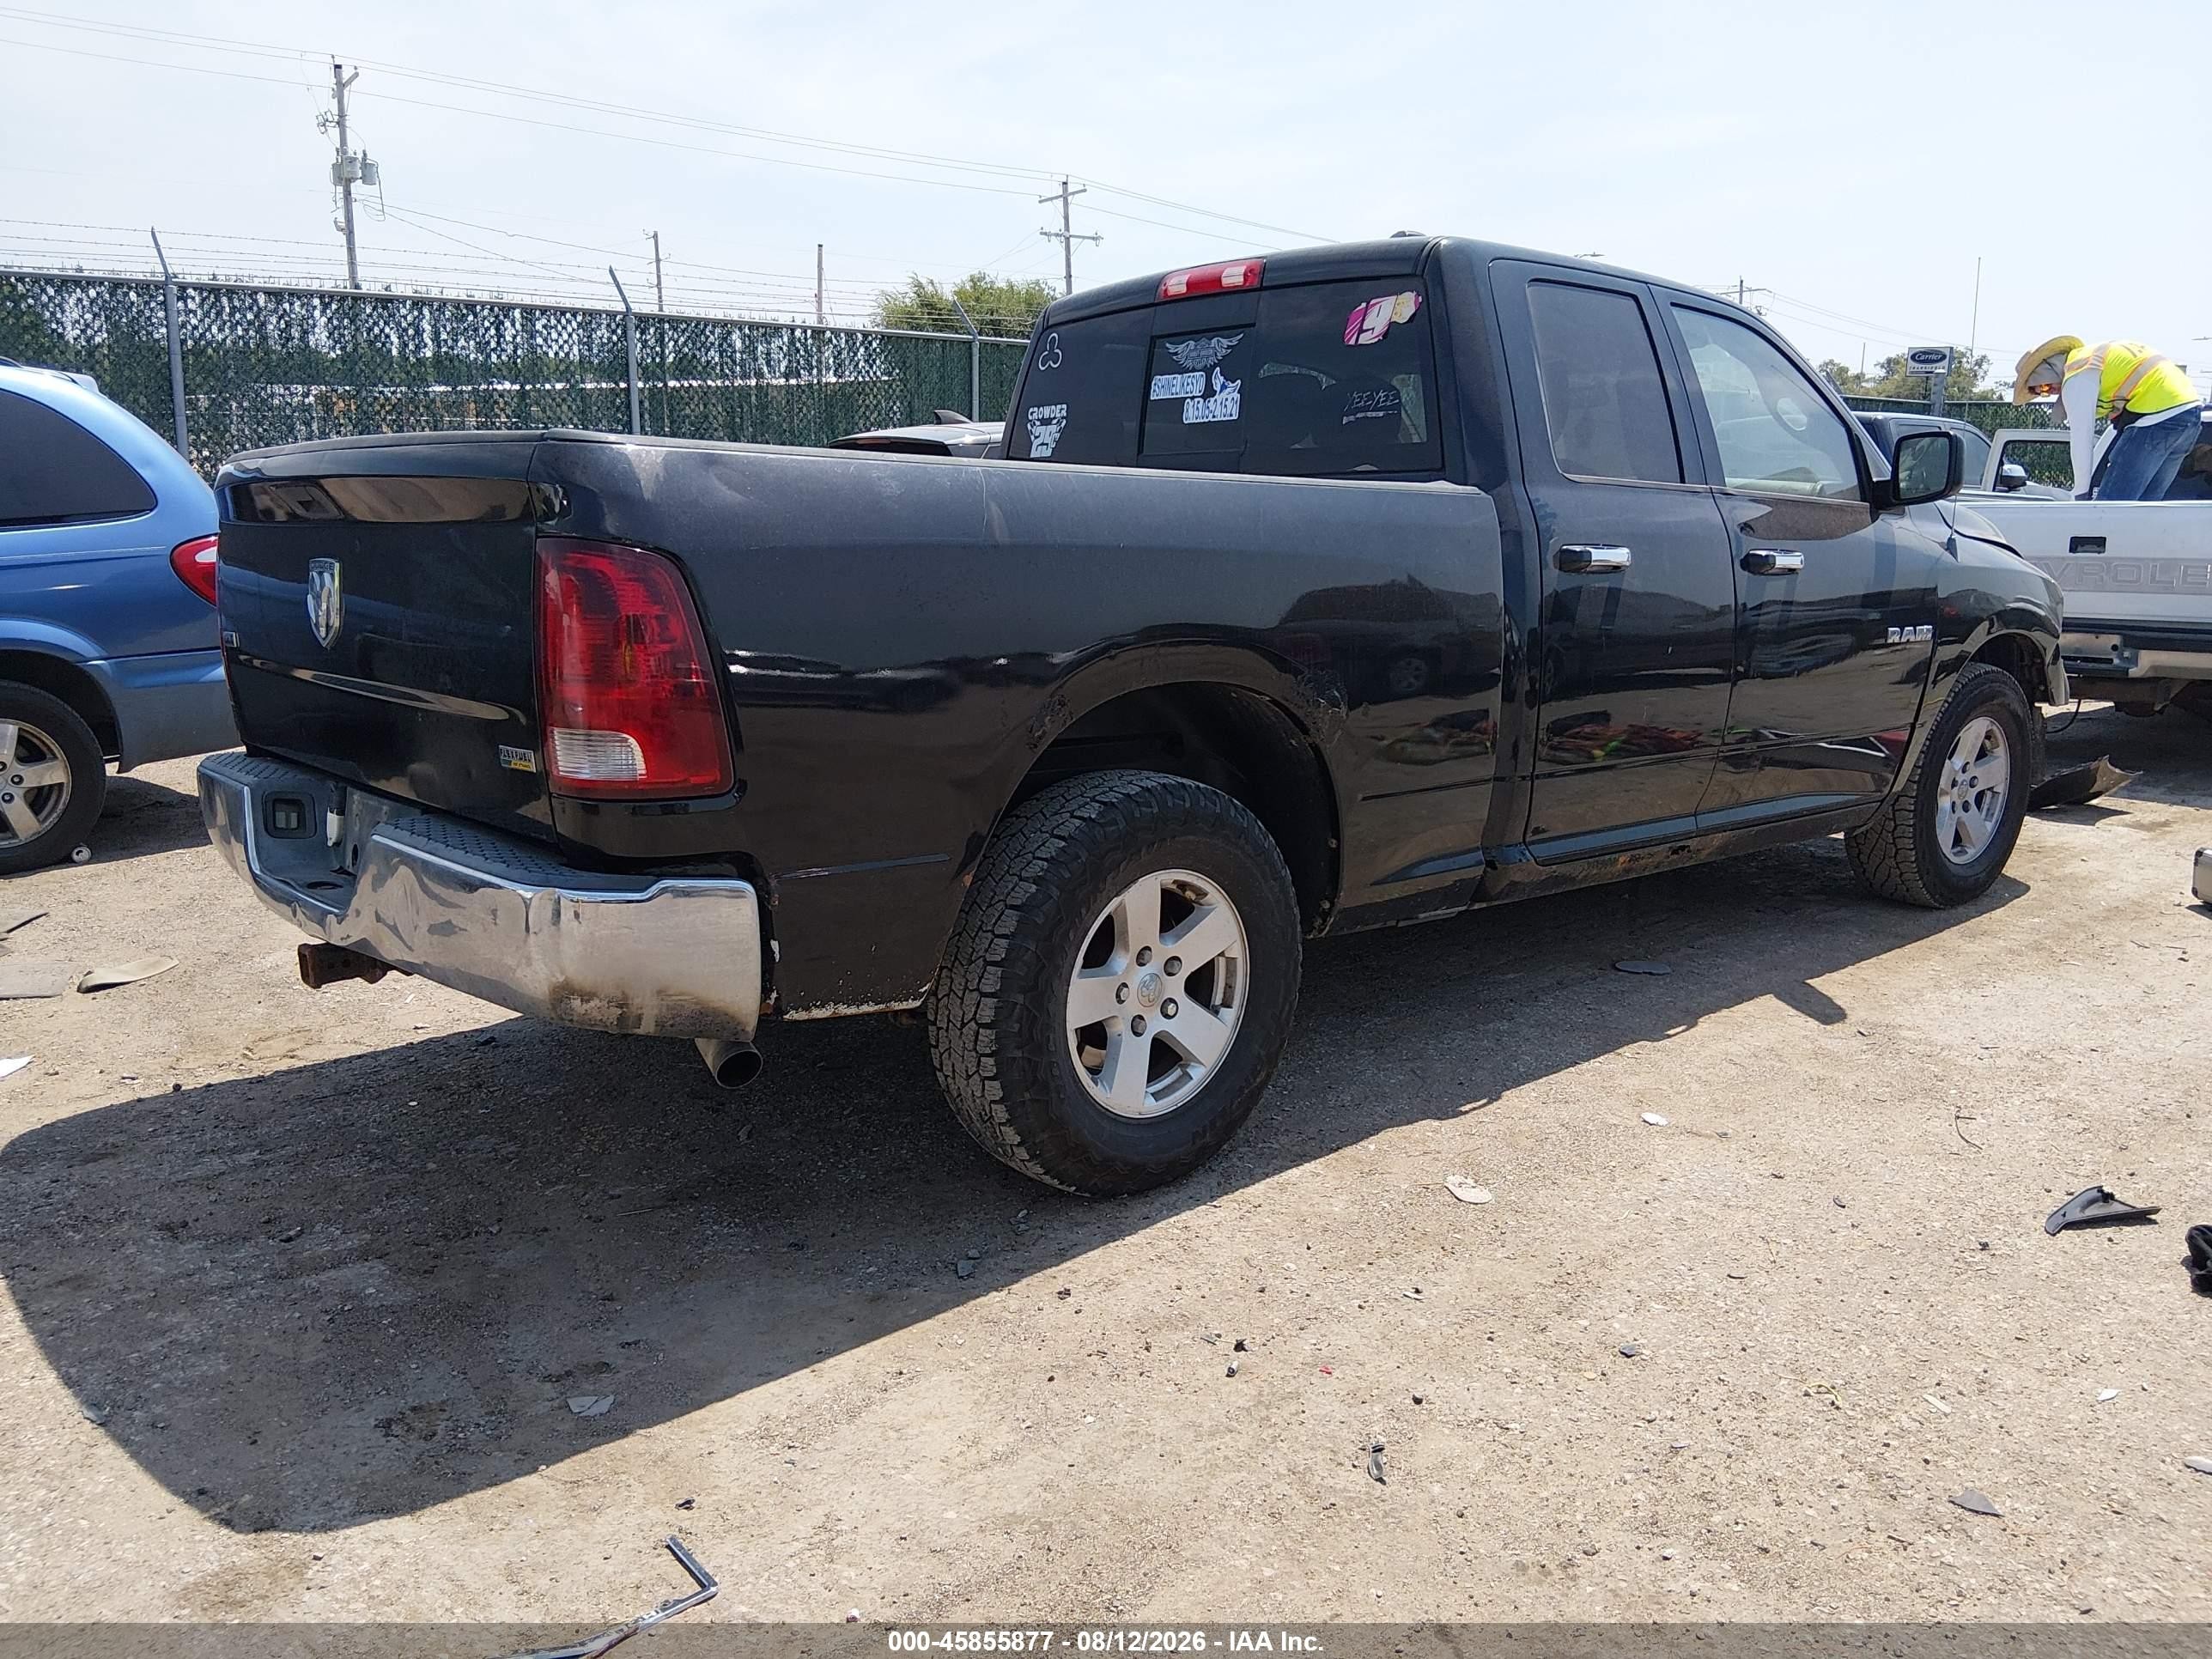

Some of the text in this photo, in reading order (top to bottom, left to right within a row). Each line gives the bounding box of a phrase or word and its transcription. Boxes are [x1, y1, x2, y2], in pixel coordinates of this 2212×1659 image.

[1152, 374, 1204, 398] #SHINELIKESYD
[1028, 404, 1067, 420] CROWDER
[2035, 561, 2211, 587] VROLE
[1887, 625, 1933, 643] RAM
